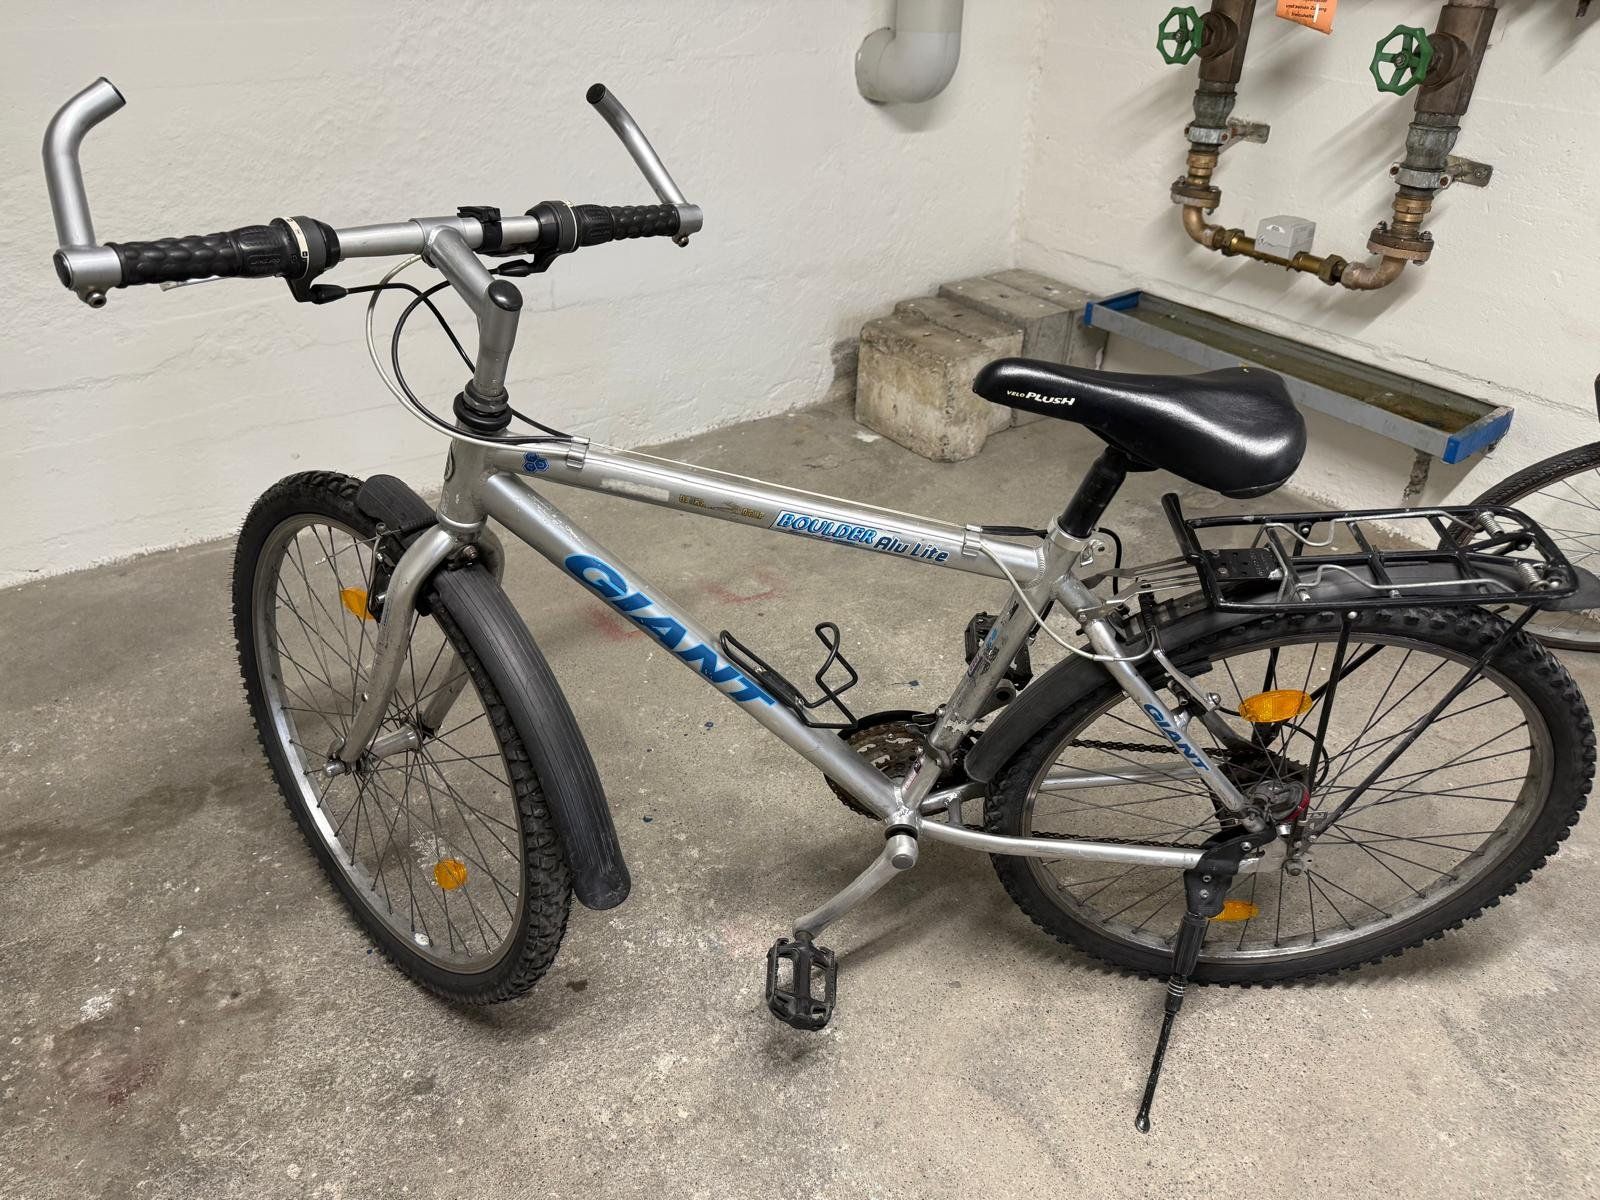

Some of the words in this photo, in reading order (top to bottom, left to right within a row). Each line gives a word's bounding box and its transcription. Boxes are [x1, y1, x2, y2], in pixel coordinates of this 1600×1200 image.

[1025, 391, 1075, 405] PLUSH
[777, 513, 878, 544] BOULDER
[873, 536, 909, 553] Alu
[909, 543, 949, 562] Lite
[564, 553, 776, 706] GIANT
[1143, 703, 1211, 771] GIANT
